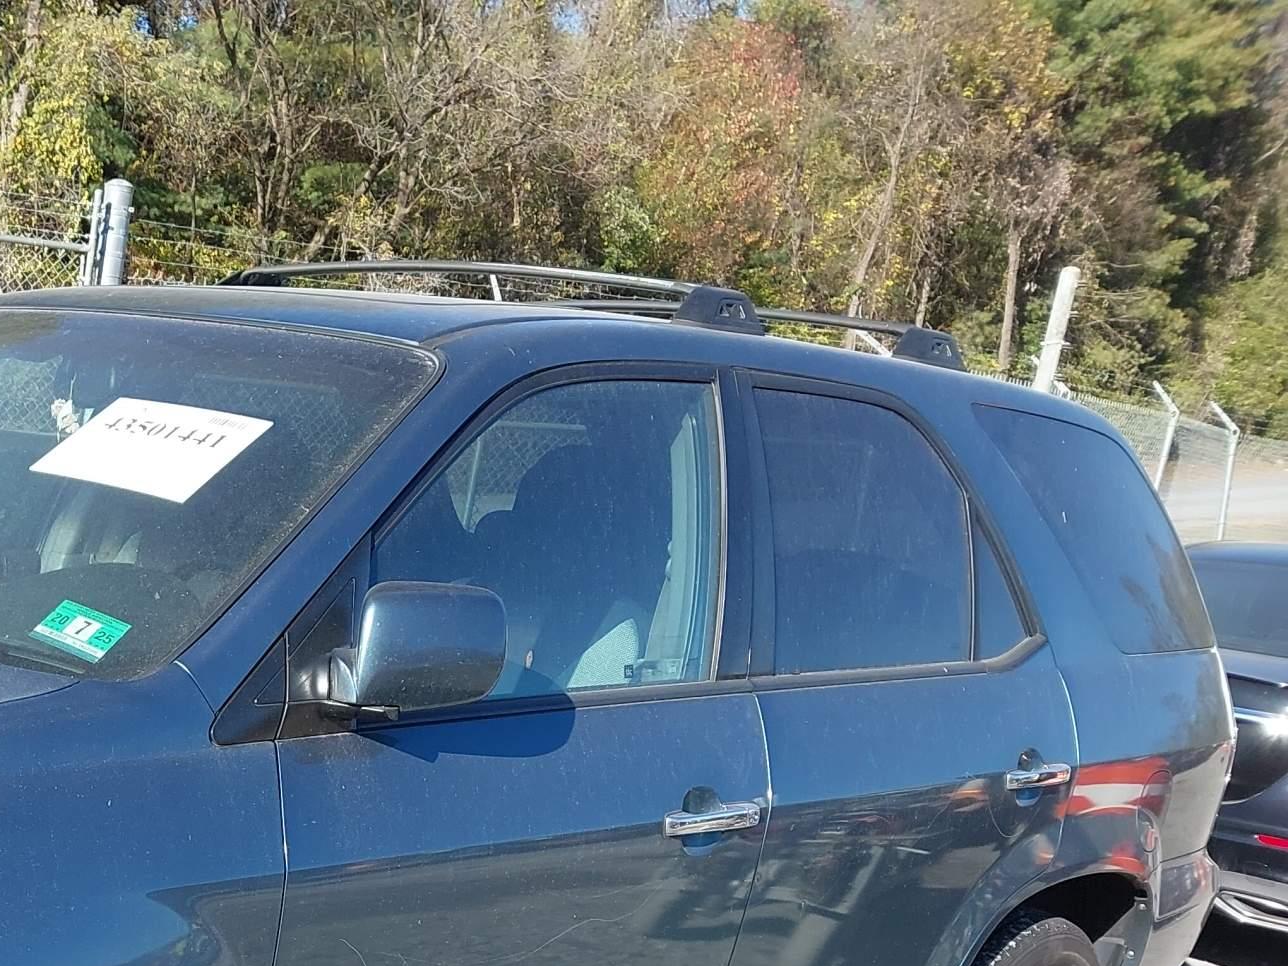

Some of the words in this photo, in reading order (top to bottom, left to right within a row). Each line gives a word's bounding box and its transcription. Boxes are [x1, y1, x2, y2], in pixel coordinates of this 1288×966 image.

[104, 417, 227, 448] 43501441
[51, 612, 70, 625] 20
[74, 620, 93, 635] 7
[94, 631, 115, 645] 25
